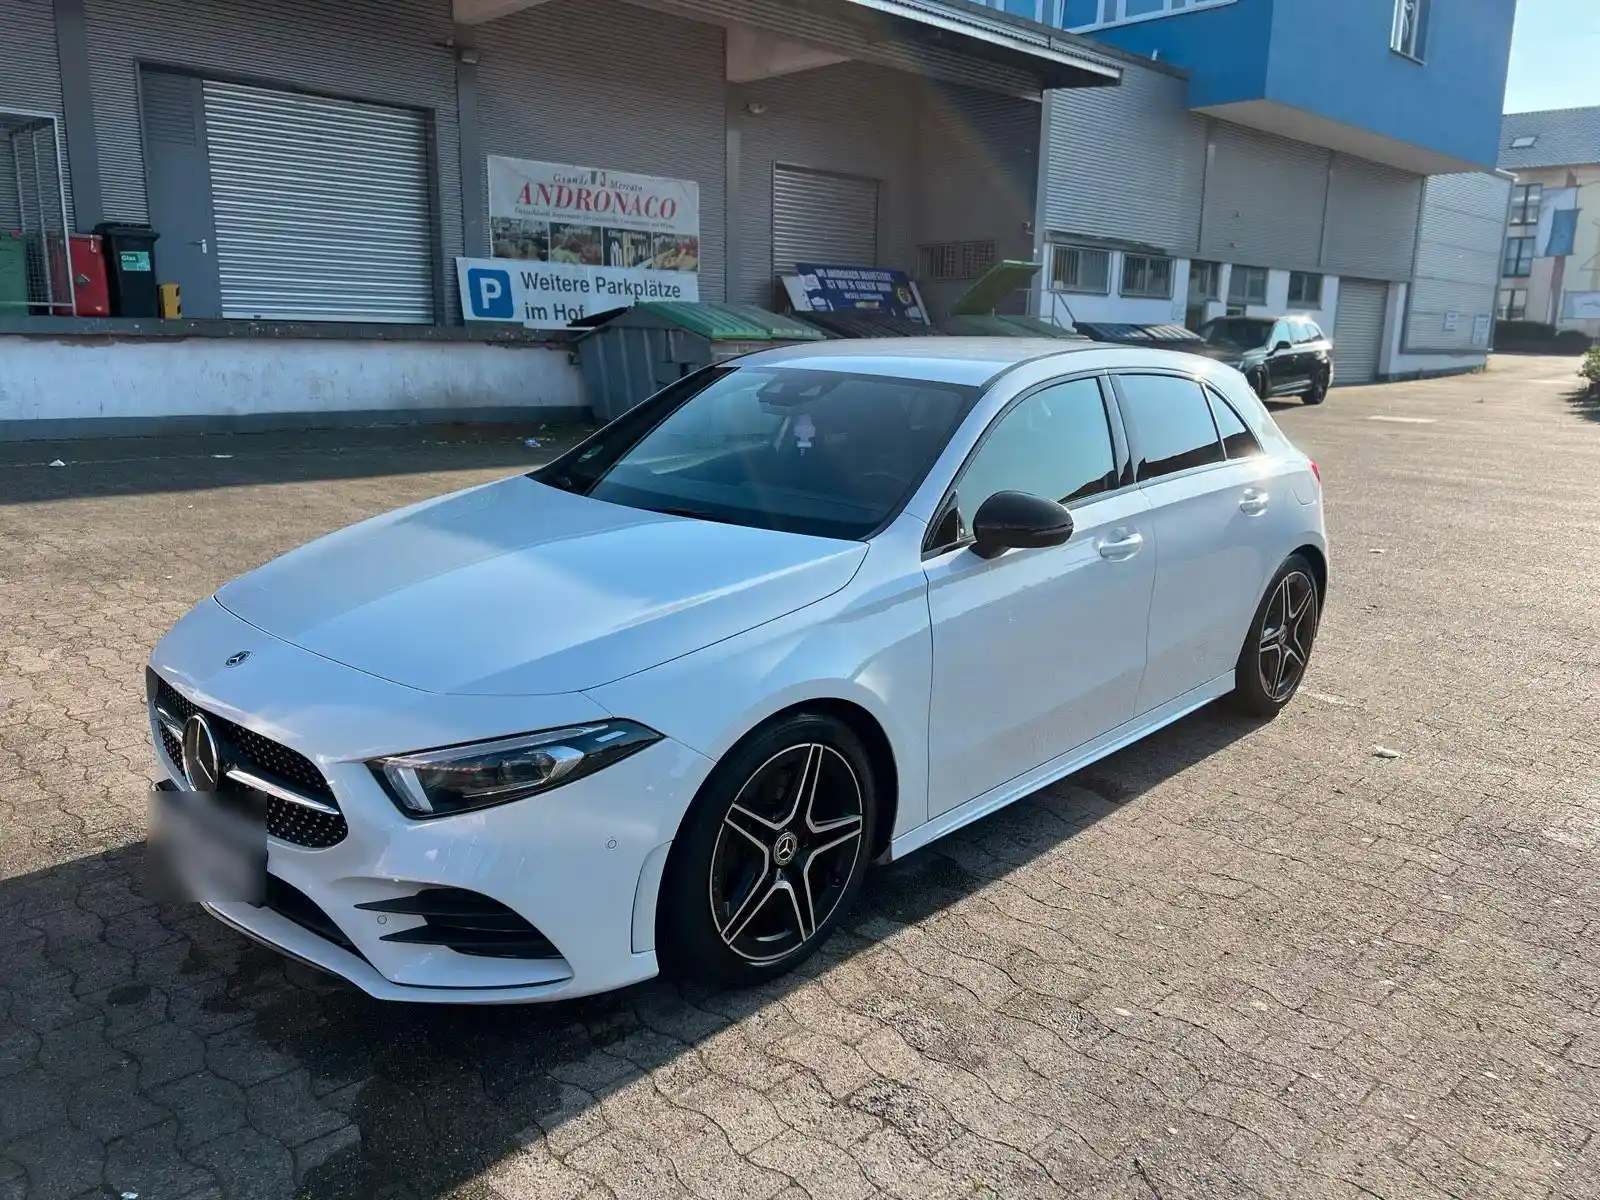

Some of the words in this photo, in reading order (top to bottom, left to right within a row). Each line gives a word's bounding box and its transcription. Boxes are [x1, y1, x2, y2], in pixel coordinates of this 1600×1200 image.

[516, 182, 676, 219] ANDRONACO
[479, 277, 502, 309] P
[520, 271, 590, 293] Weitere
[595, 276, 681, 300] Parkplätze
[524, 302, 548, 321] im
[553, 303, 585, 321] Hof
